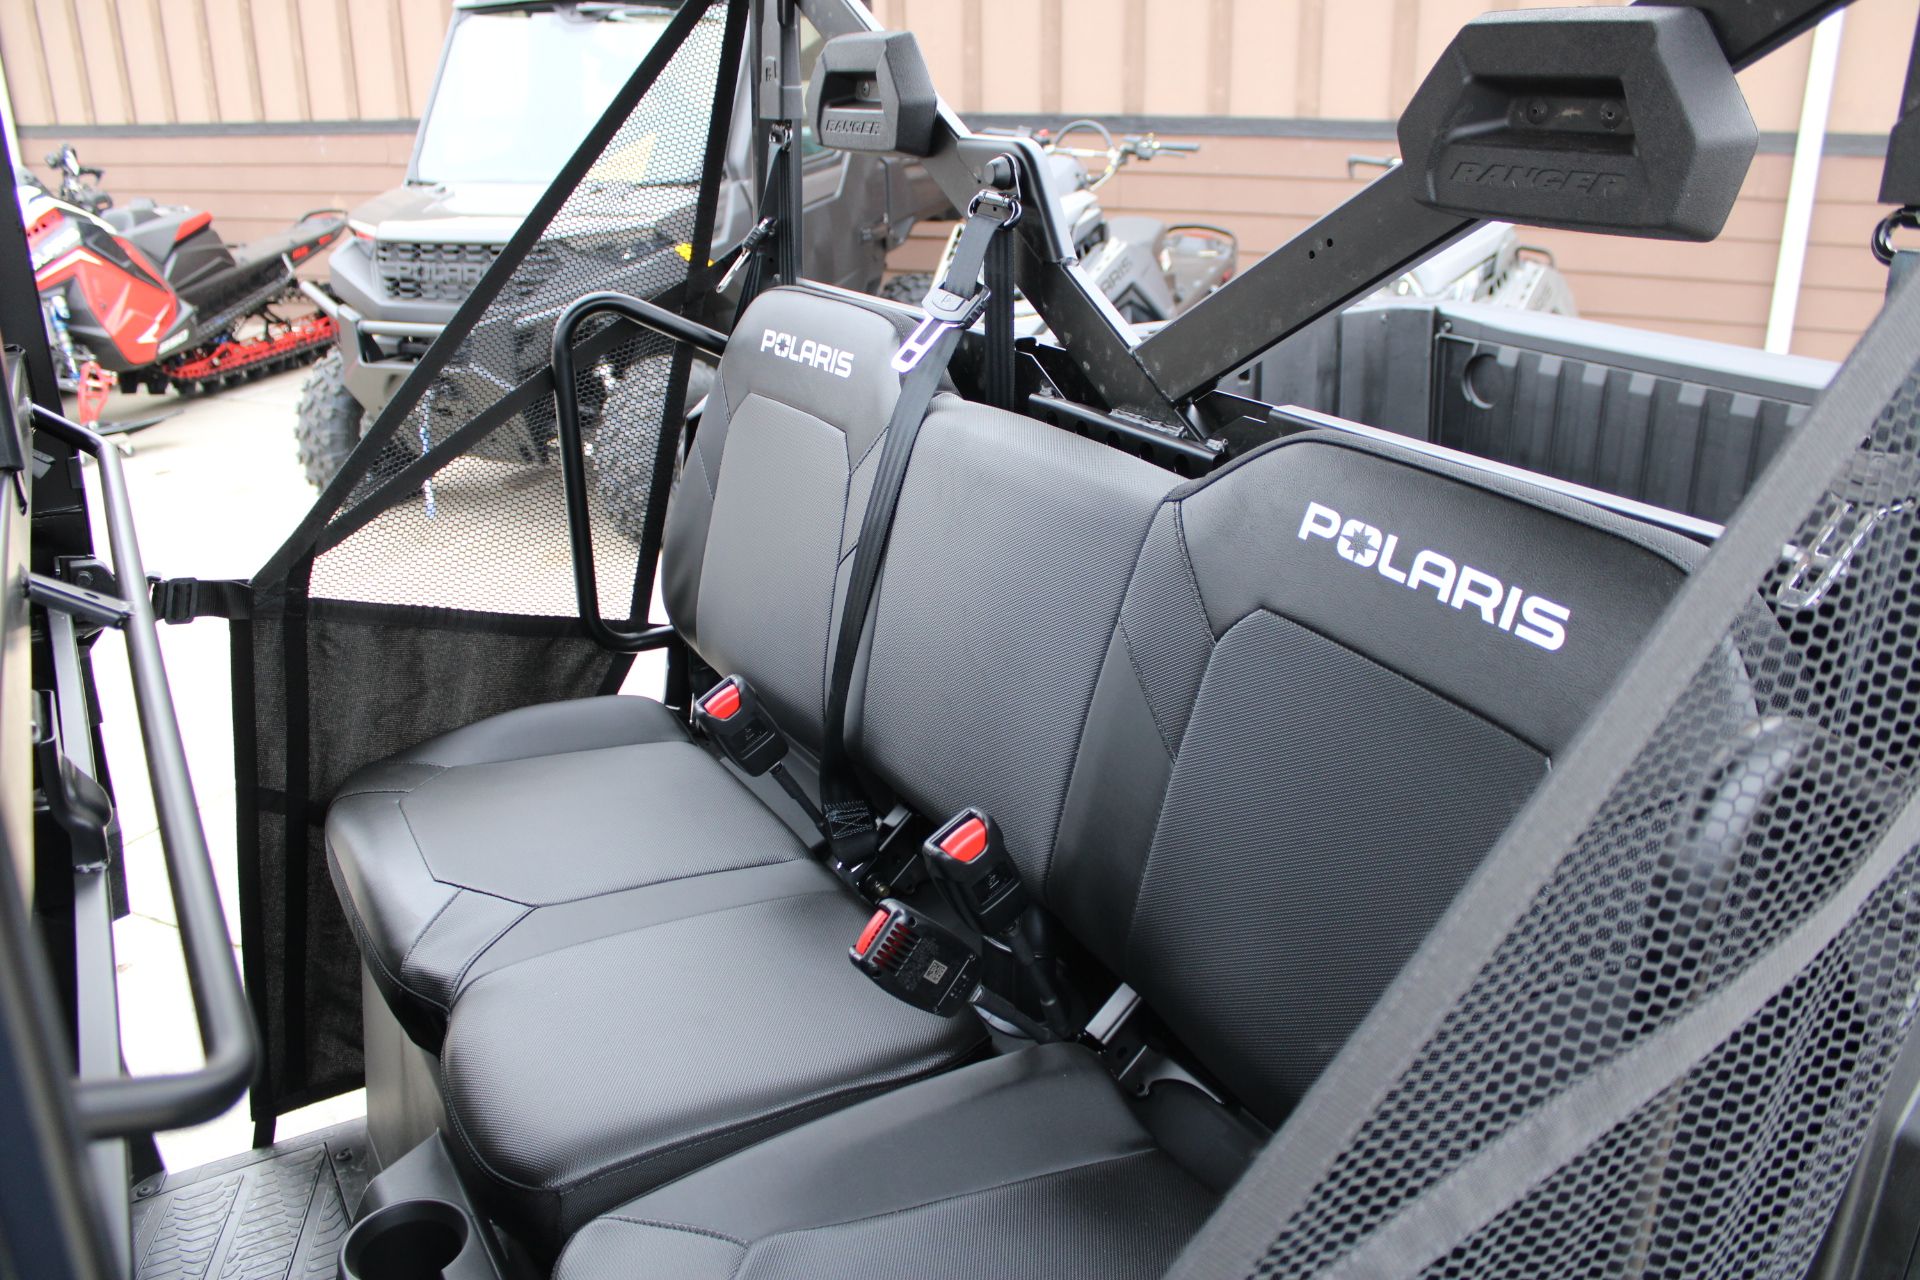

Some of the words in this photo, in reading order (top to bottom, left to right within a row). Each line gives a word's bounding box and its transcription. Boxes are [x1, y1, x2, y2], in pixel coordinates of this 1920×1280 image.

[825, 119, 881, 135] RANGER
[1450, 161, 1627, 197] RANGER
[760, 328, 855, 379] POLARIS
[1297, 501, 1571, 651] POLARIS
